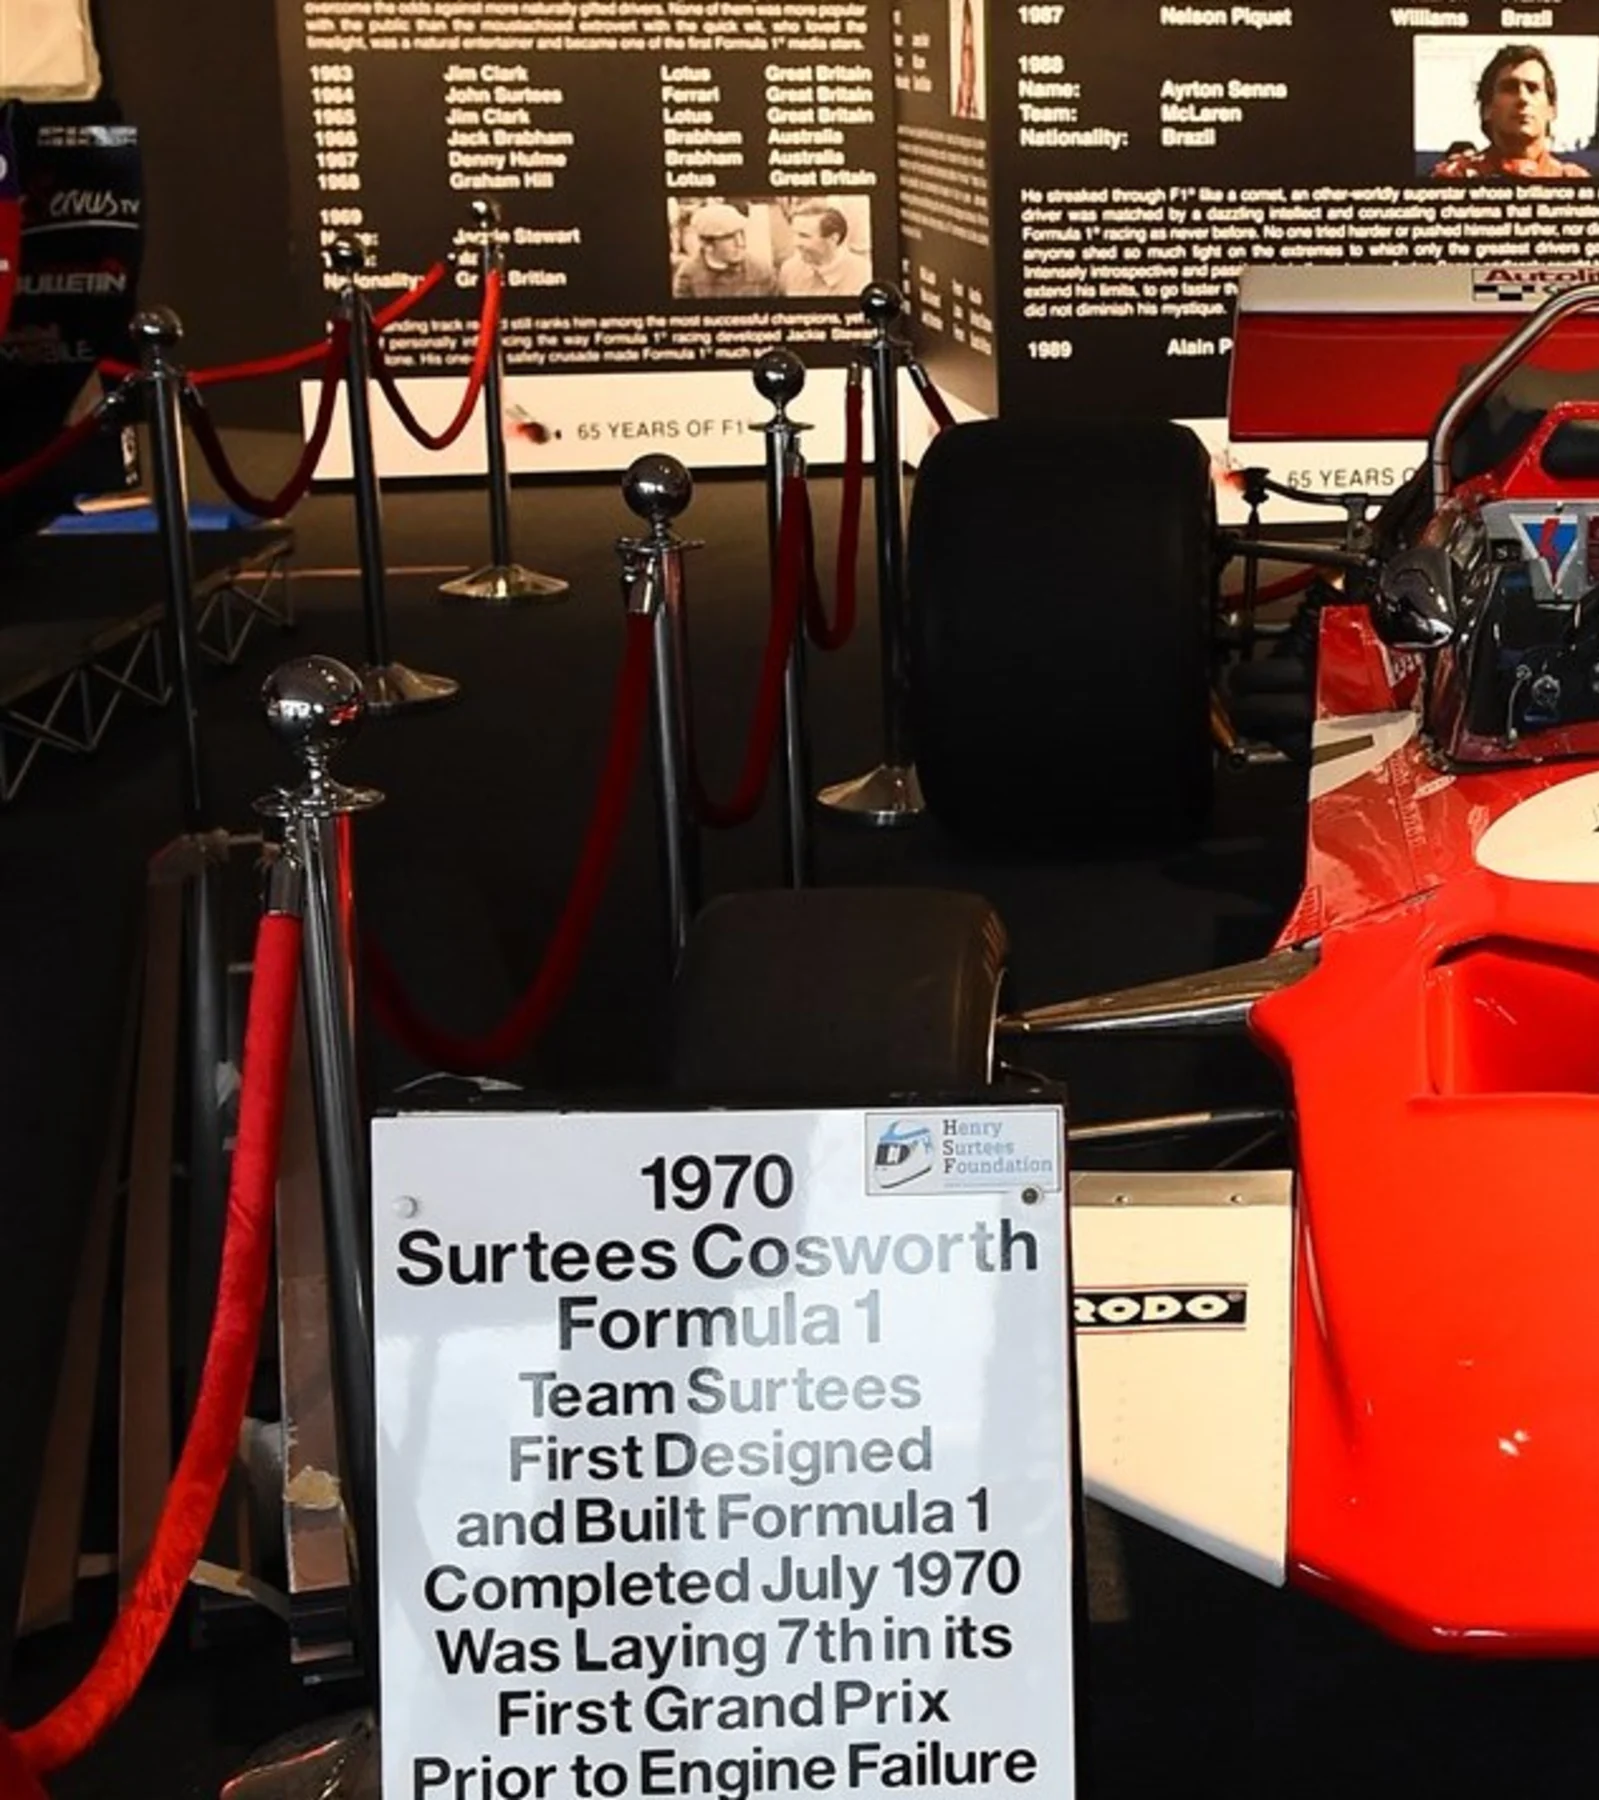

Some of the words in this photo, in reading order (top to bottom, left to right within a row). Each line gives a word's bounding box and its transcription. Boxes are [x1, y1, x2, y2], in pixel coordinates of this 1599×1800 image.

[1160, 6, 1227, 25] Nelson
[1231, 7, 1292, 29] Piquet
[1390, 8, 1469, 27] Williams
[1501, 9, 1552, 28] Brazil
[444, 65, 478, 82] Jim
[480, 64, 528, 82] Clark
[661, 65, 711, 82] Lotus
[765, 65, 812, 81] Great
[816, 65, 872, 81] Britain
[445, 86, 491, 104] John
[494, 86, 563, 104] Surtees
[662, 86, 720, 103] Ferrari
[766, 86, 814, 103] Great
[817, 86, 873, 102] Britain
[1019, 79, 1080, 98] Name:
[1160, 80, 1224, 102] Ayrton
[1228, 80, 1287, 98] Senna
[446, 108, 480, 125] Jim
[483, 108, 530, 125] Clark
[663, 108, 713, 124] Lotus
[767, 107, 814, 124] Great
[817, 107, 874, 124] Britain
[1019, 103, 1077, 122] Team:
[1161, 104, 1242, 122] McLaren
[447, 130, 490, 146] Jack
[493, 129, 574, 146] Brabham
[664, 129, 742, 145] Brabham
[768, 128, 844, 144] Australia
[1020, 128, 1128, 150] Nationality:
[1162, 127, 1216, 146] Brazil
[448, 151, 506, 170] Denny
[510, 151, 567, 167] Hulme
[665, 149, 743, 166] Brabham
[769, 149, 845, 165] Australia
[450, 172, 521, 189] Graham
[524, 172, 554, 188] Hill
[666, 171, 716, 187] Lotus
[770, 169, 817, 187] Great
[820, 169, 876, 186] Britain
[514, 227, 580, 244] Stewart
[1024, 303, 1047, 317] did
[1049, 304, 1072, 317] not
[1137, 302, 1158, 316] his
[599, 317, 644, 330] among
[646, 316, 667, 327] the
[669, 315, 701, 327] most
[1029, 341, 1072, 358] 1989
[1167, 339, 1214, 355] Alain
[578, 423, 600, 440] 65
[607, 421, 680, 438] YEARS
[687, 420, 715, 437] OF
[1288, 472, 1312, 488] 65
[1320, 468, 1394, 487] YEARS
[943, 1120, 1002, 1137] Henry
[943, 1139, 1014, 1156] Surtees
[944, 1156, 1052, 1173] Foundation
[642, 1154, 792, 1208] 1970
[396, 1229, 677, 1285] Surtees
[692, 1219, 1037, 1279] Cosworth
[1075, 1295, 1229, 1323] RODO
[558, 1294, 840, 1351] Formula
[854, 1289, 881, 1343] 1
[519, 1369, 673, 1418] Team
[687, 1367, 922, 1414] Surtees
[509, 1435, 642, 1483] First
[656, 1428, 932, 1487] Designed
[455, 1499, 565, 1548] and
[576, 1495, 706, 1544] Built
[717, 1491, 954, 1540] Formula
[967, 1487, 989, 1533] 1
[424, 1558, 748, 1620] Completed
[762, 1554, 877, 1609] July
[893, 1548, 1020, 1598] 1970
[436, 1628, 559, 1674] Was
[575, 1624, 768, 1677] Laying
[777, 1618, 873, 1664] 7th
[885, 1616, 929, 1661] in
[944, 1616, 1012, 1658] its
[499, 1690, 632, 1736] First
[646, 1681, 824, 1731] Grand
[837, 1680, 950, 1725] Prix
[413, 1755, 557, 1800] Prior
[571, 1753, 627, 1795] to
[642, 1747, 835, 1800] Engine
[848, 1742, 1037, 1790] Failure
